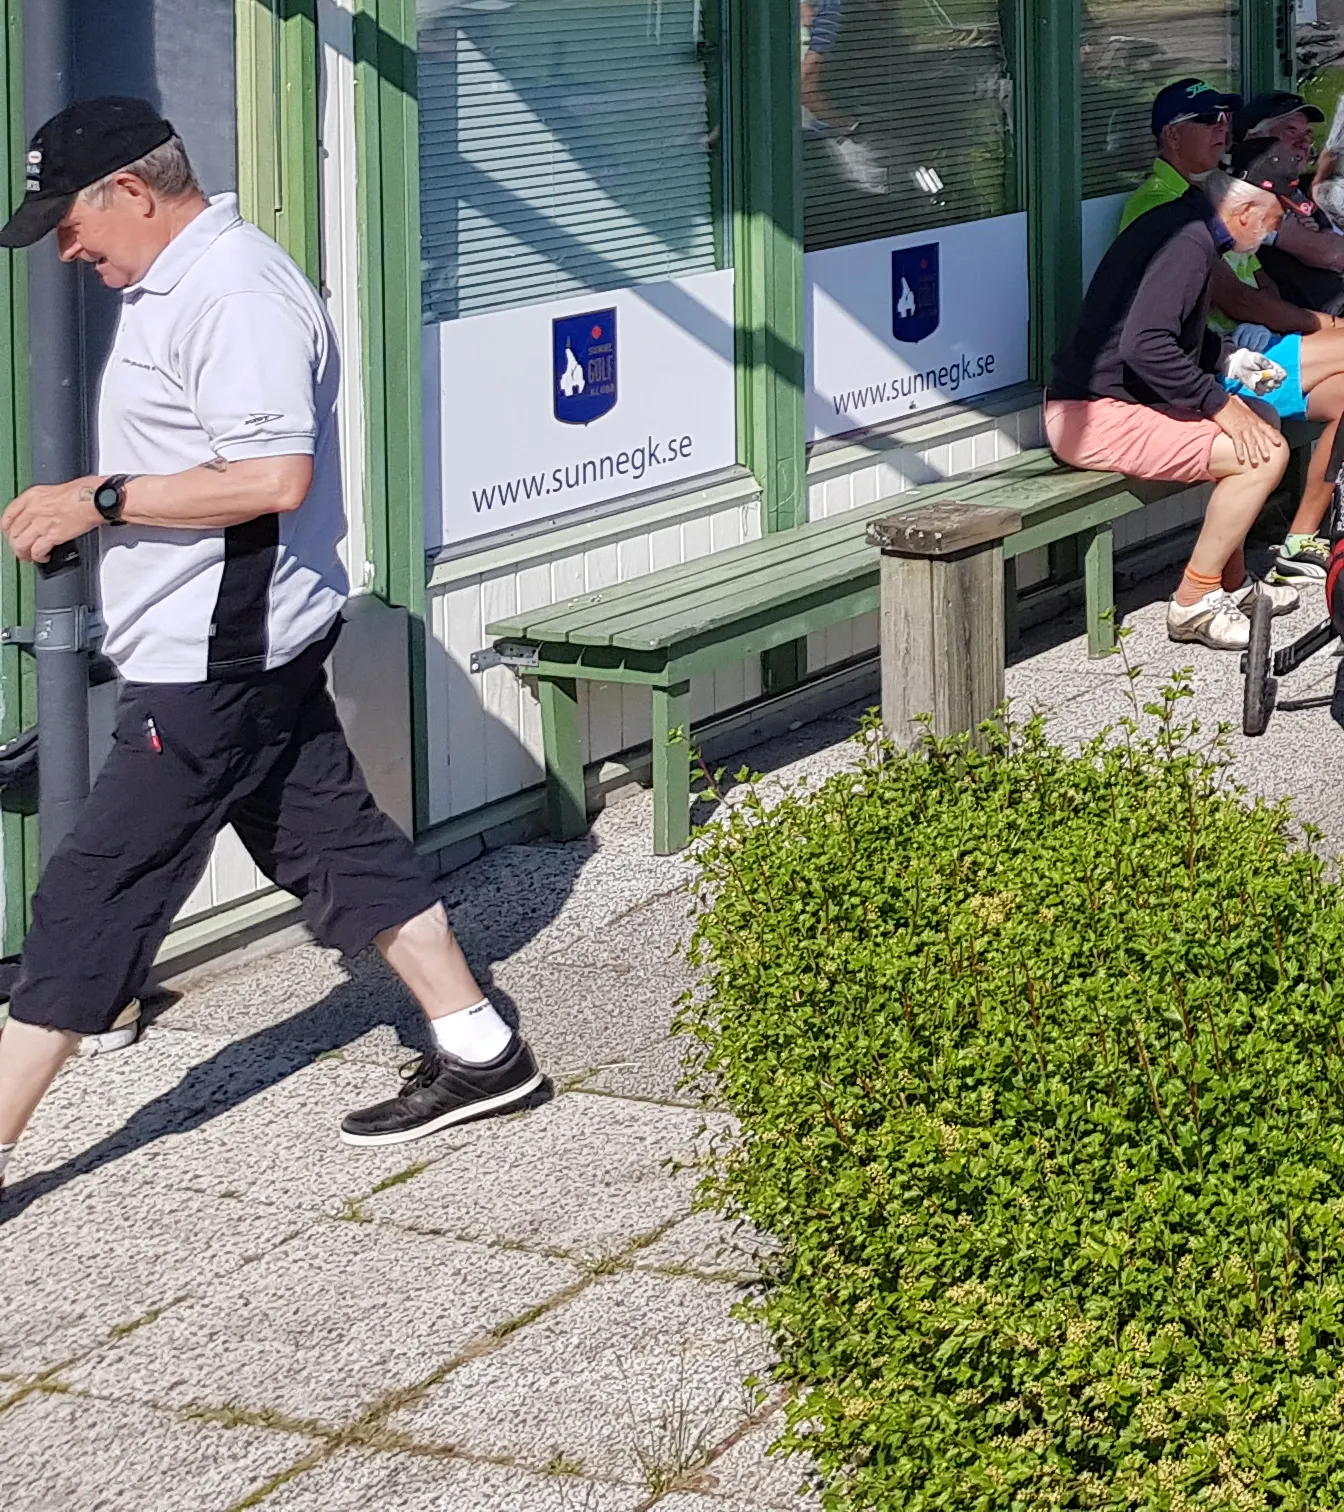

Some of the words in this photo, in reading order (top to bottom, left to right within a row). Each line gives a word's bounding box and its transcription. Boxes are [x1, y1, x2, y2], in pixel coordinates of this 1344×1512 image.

[587, 355, 614, 384] GOLF
[832, 352, 996, 416] www.sunnegk.se
[472, 434, 693, 513] www.sunnegk.se
